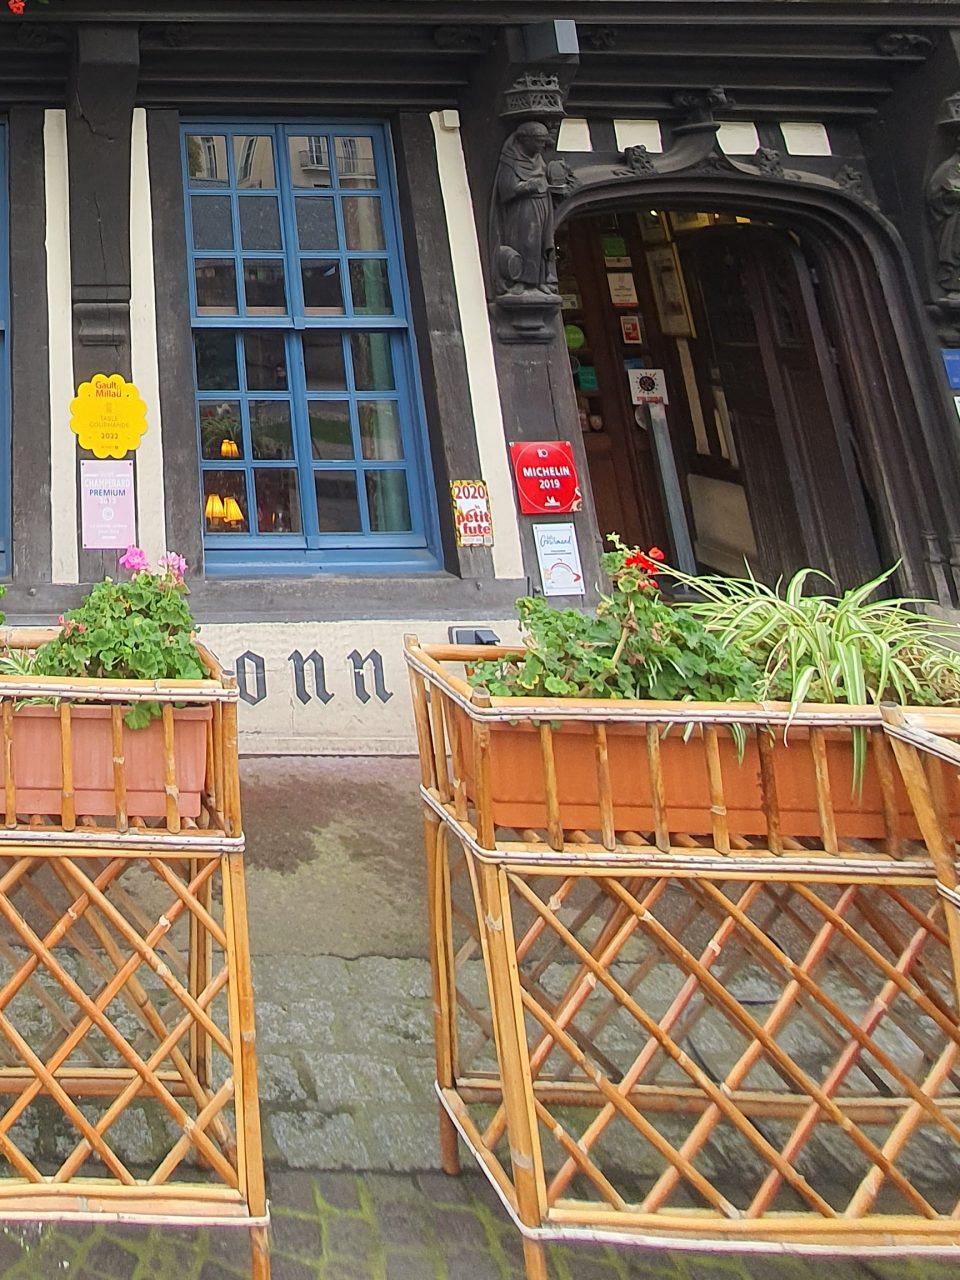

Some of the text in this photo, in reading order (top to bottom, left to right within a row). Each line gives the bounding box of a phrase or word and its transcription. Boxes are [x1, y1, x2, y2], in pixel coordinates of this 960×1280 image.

[95, 380, 117, 389] Gault
[95, 389, 122, 398] Millau
[522, 466, 570, 477] MICHELIN
[538, 478, 560, 489] 2019
[89, 488, 126, 497] PREMIUM
[454, 484, 486, 500] 2020
[456, 510, 491, 526] petit
